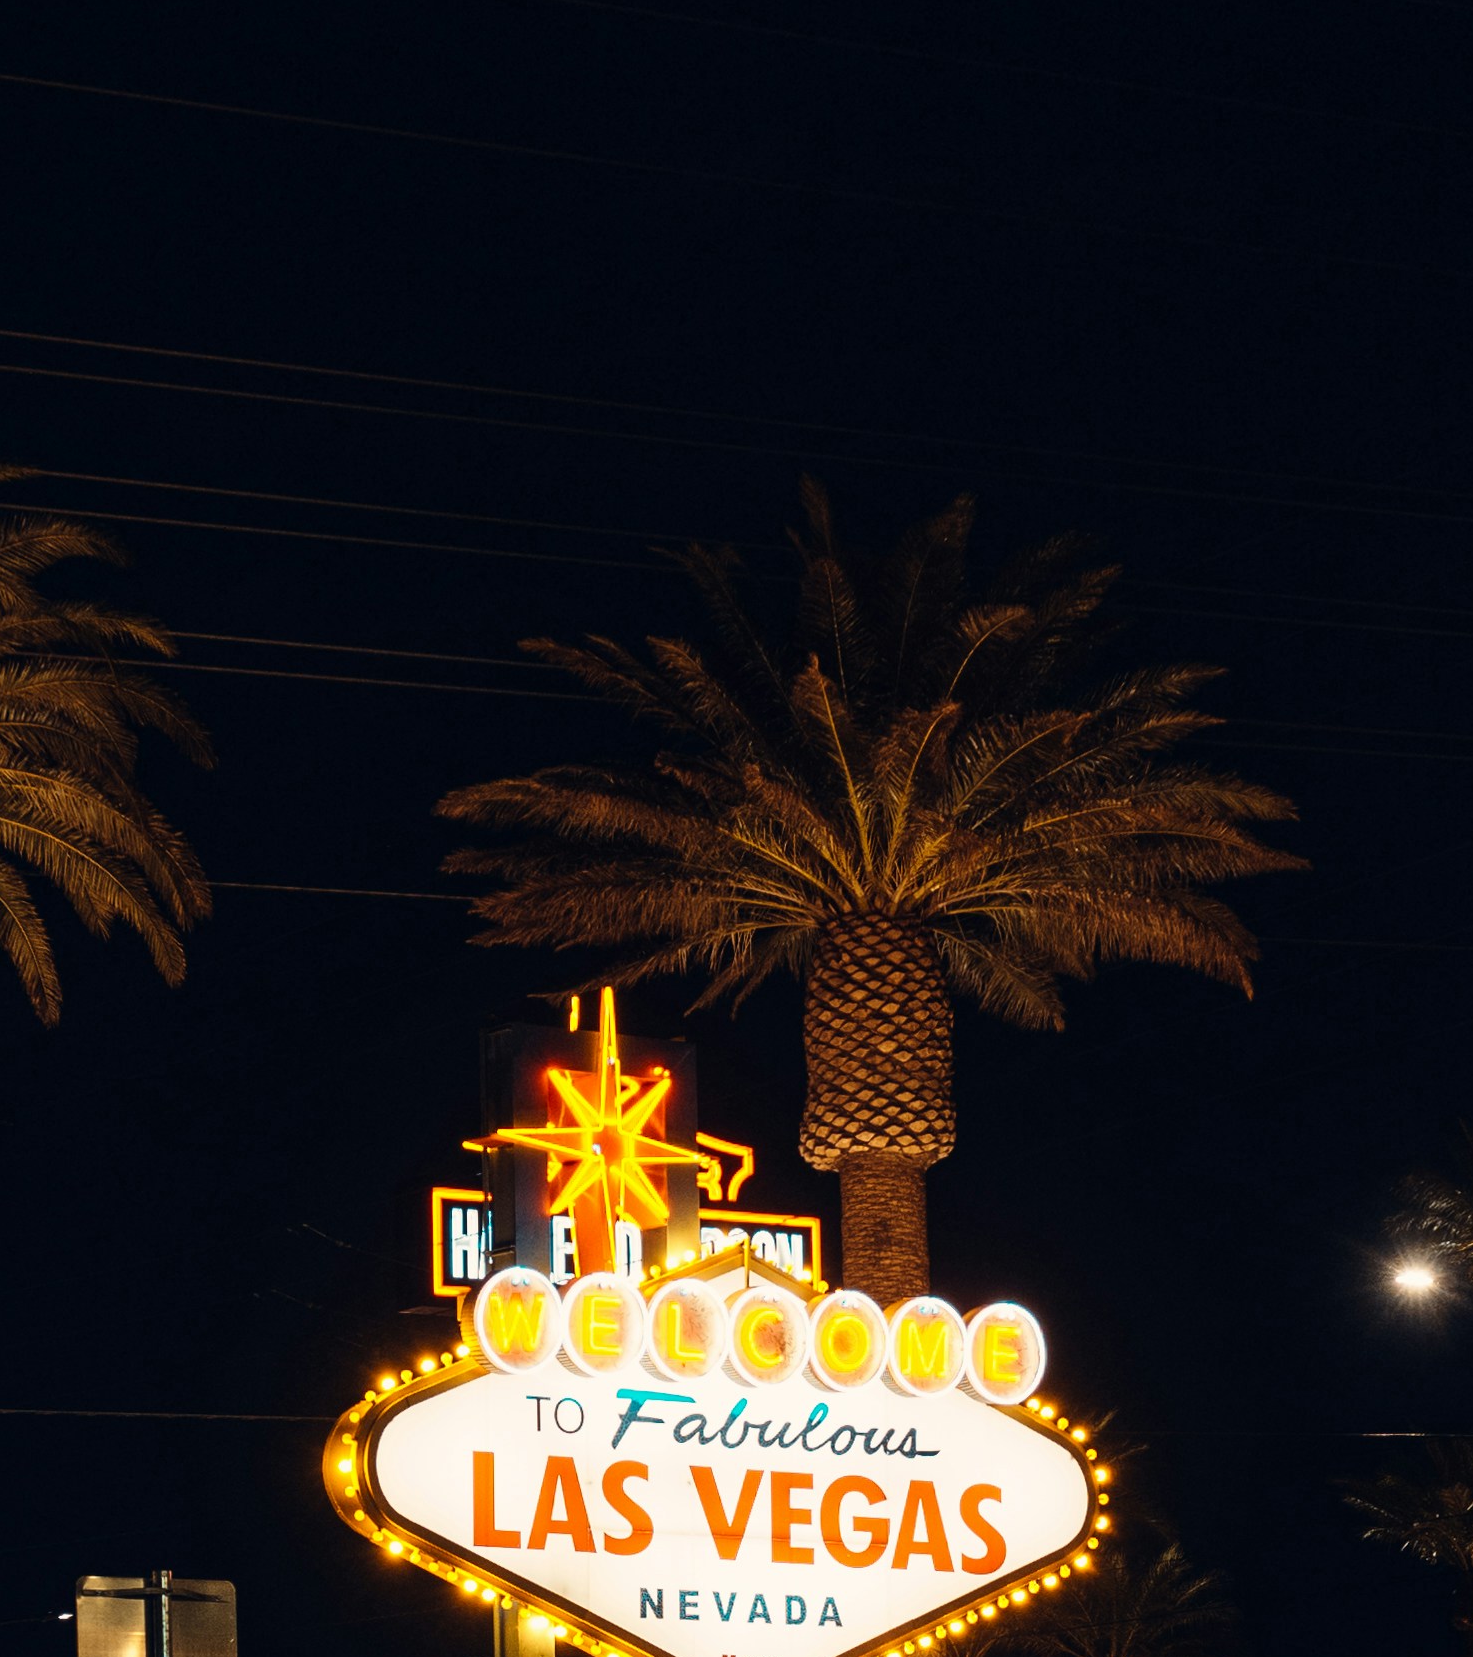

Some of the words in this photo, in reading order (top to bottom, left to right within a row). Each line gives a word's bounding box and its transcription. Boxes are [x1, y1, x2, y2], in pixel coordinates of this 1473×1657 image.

[488, 1291, 1021, 1383] WELCOME
[526, 1395, 585, 1434] TO
[611, 1388, 941, 1459] Fabulous
[472, 1450, 655, 1556] LAS
[689, 1464, 1007, 1576] VEGAS
[639, 1587, 843, 1628] NEVADA
